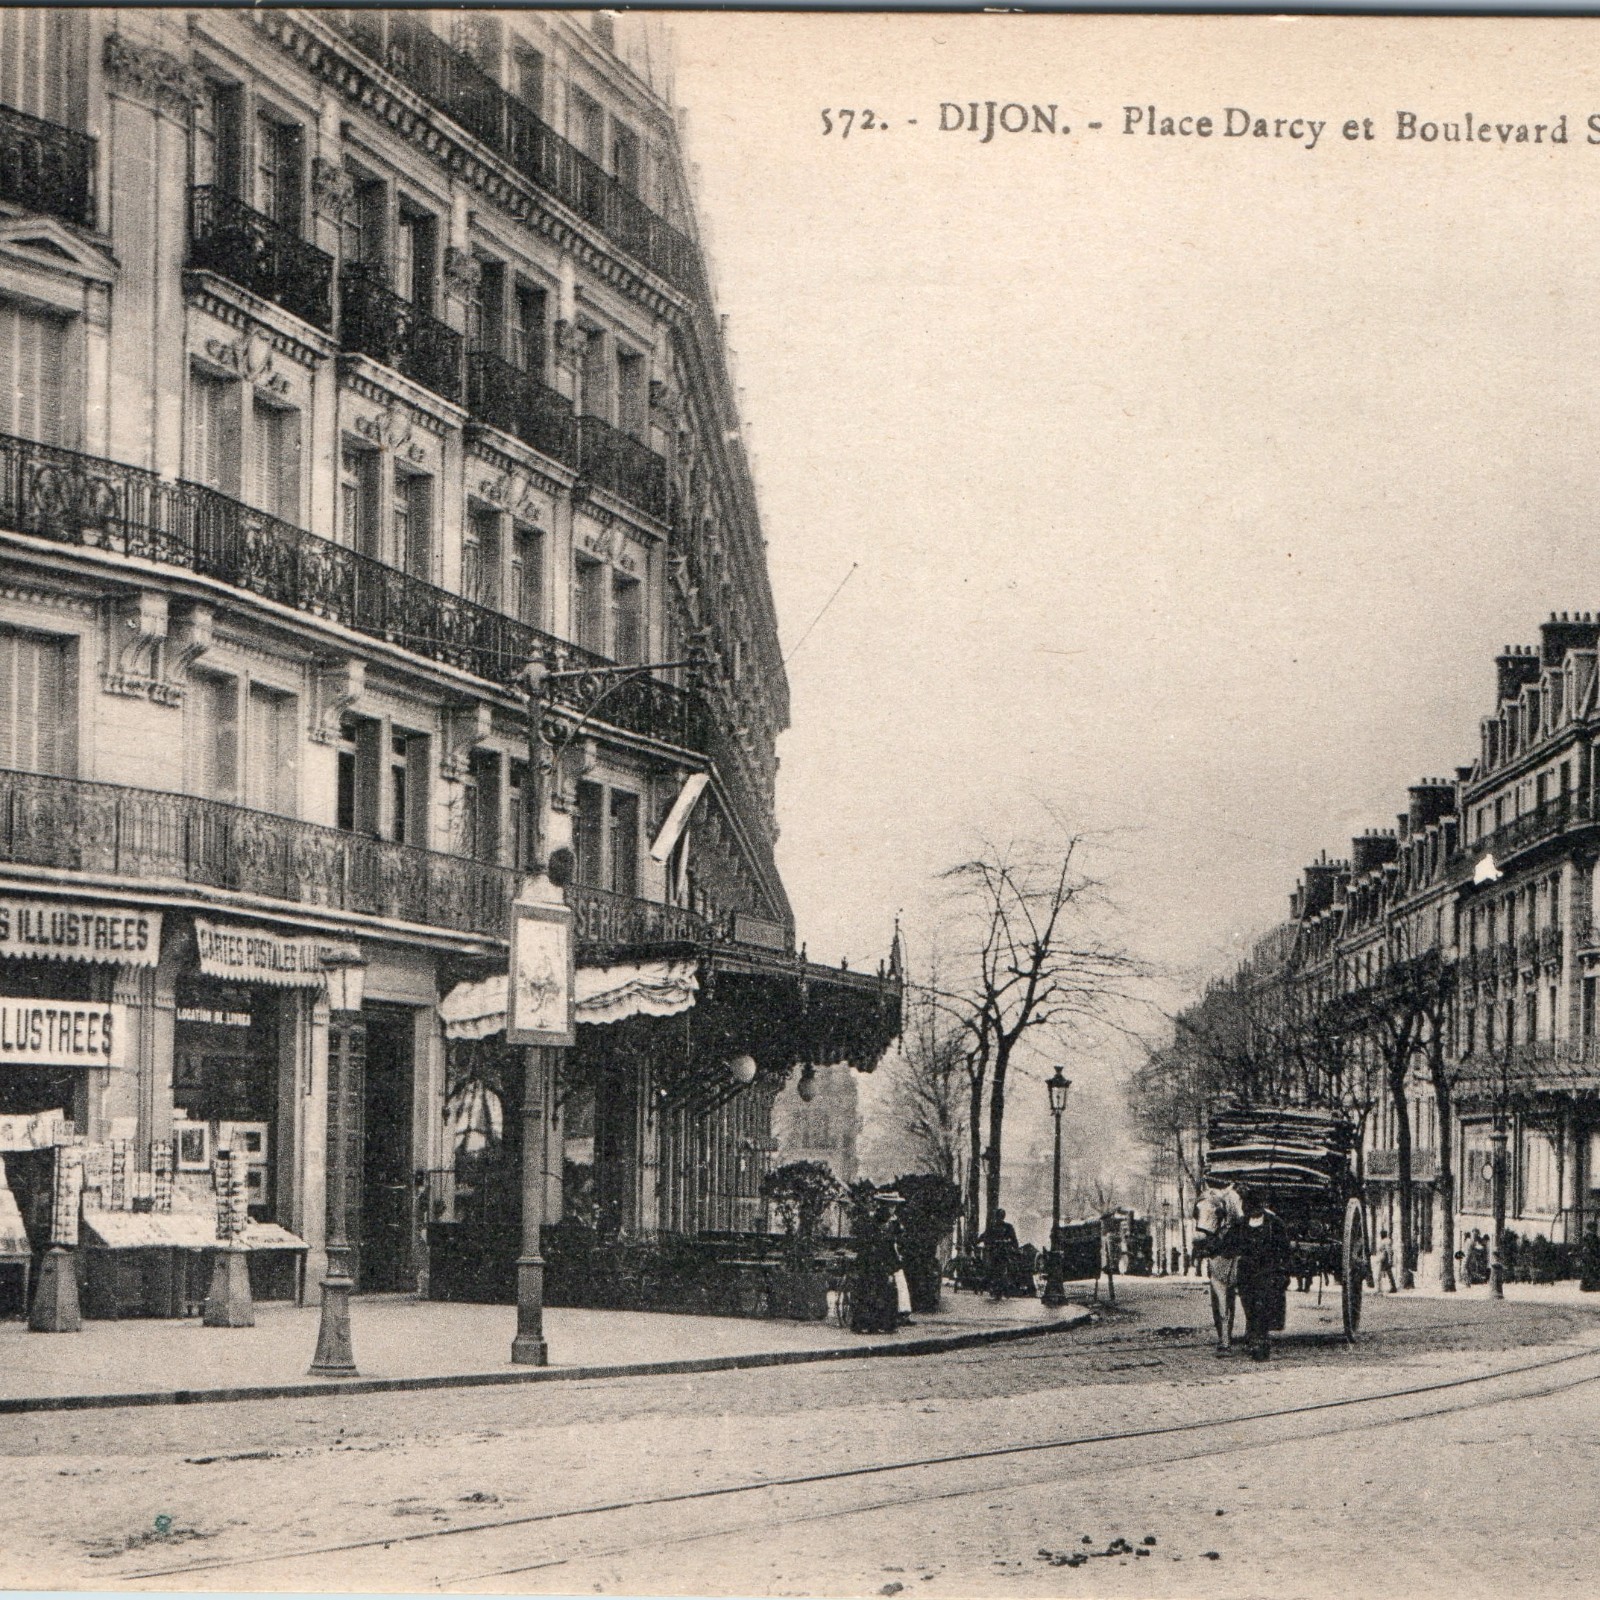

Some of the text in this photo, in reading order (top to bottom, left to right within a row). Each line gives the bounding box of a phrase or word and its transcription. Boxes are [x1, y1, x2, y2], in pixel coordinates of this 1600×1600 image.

[17, 908, 149, 951] ILLUSTREES
[200, 929, 244, 967] CARTES
[246, 936, 298, 973] POSTALES
